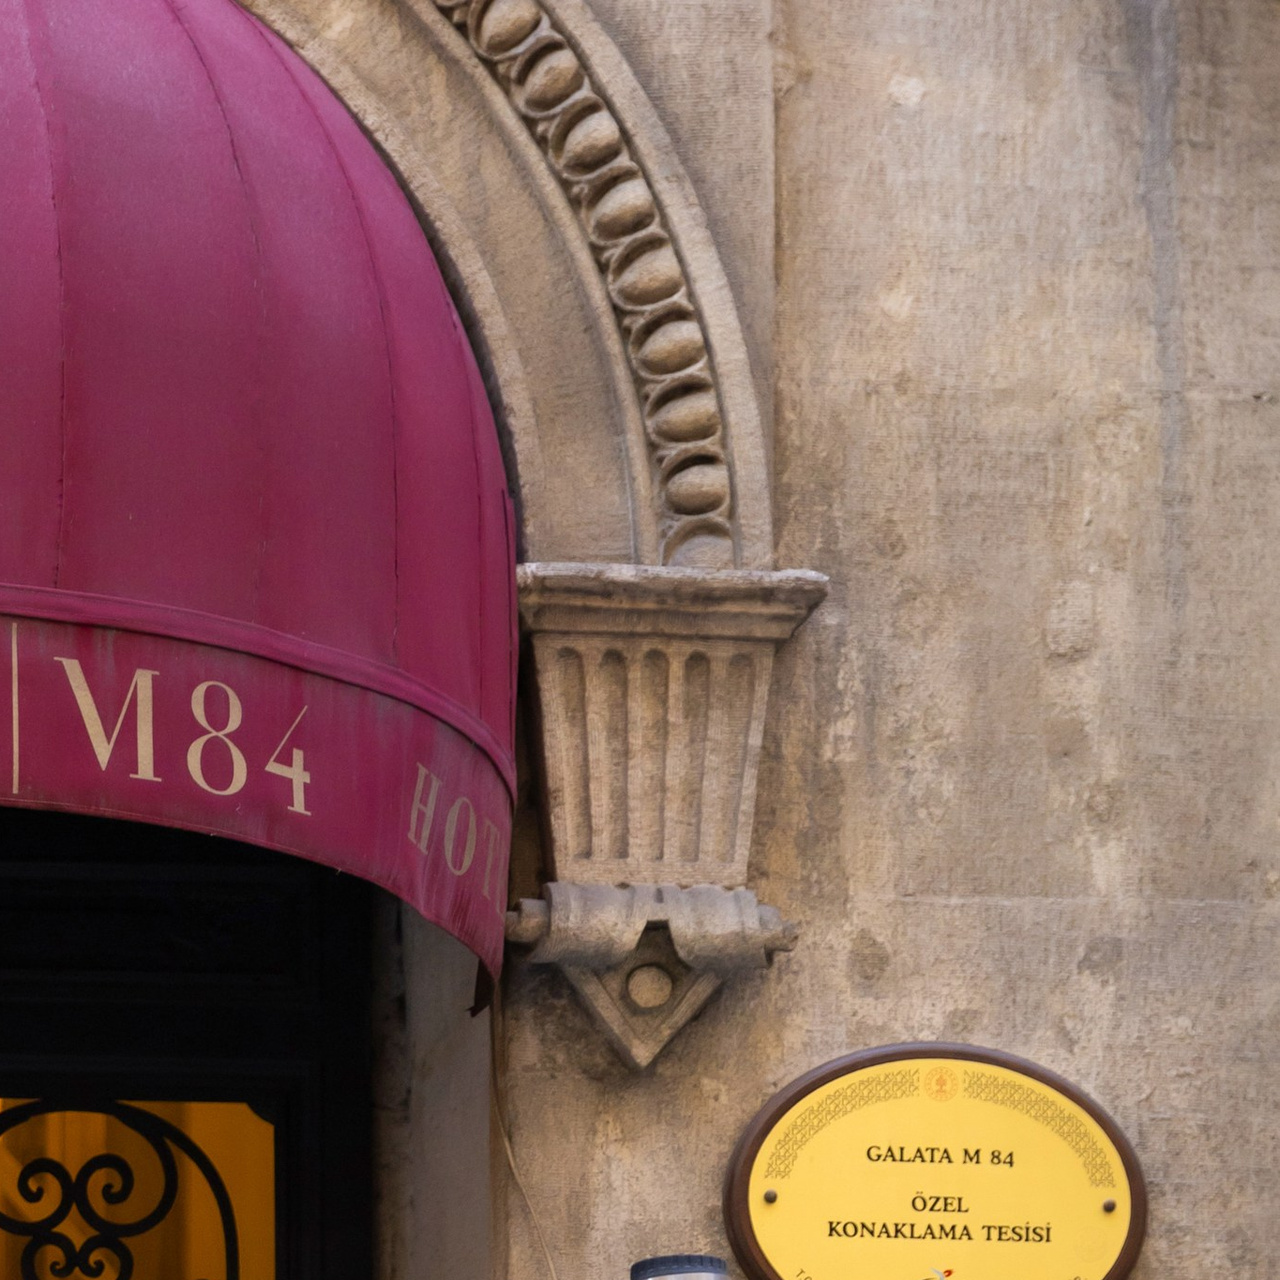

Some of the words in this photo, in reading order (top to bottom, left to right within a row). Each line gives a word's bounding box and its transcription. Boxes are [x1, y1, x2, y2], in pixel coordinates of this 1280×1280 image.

[54, 657, 314, 816] M84
[866, 1146, 954, 1165] GALATA
[962, 1149, 982, 1165] M
[990, 1149, 1015, 1168] 84
[911, 1191, 970, 1214] ÖZEL
[827, 1221, 973, 1242] KONAKLAMA
[981, 1222, 1053, 1243] TESİSİ
